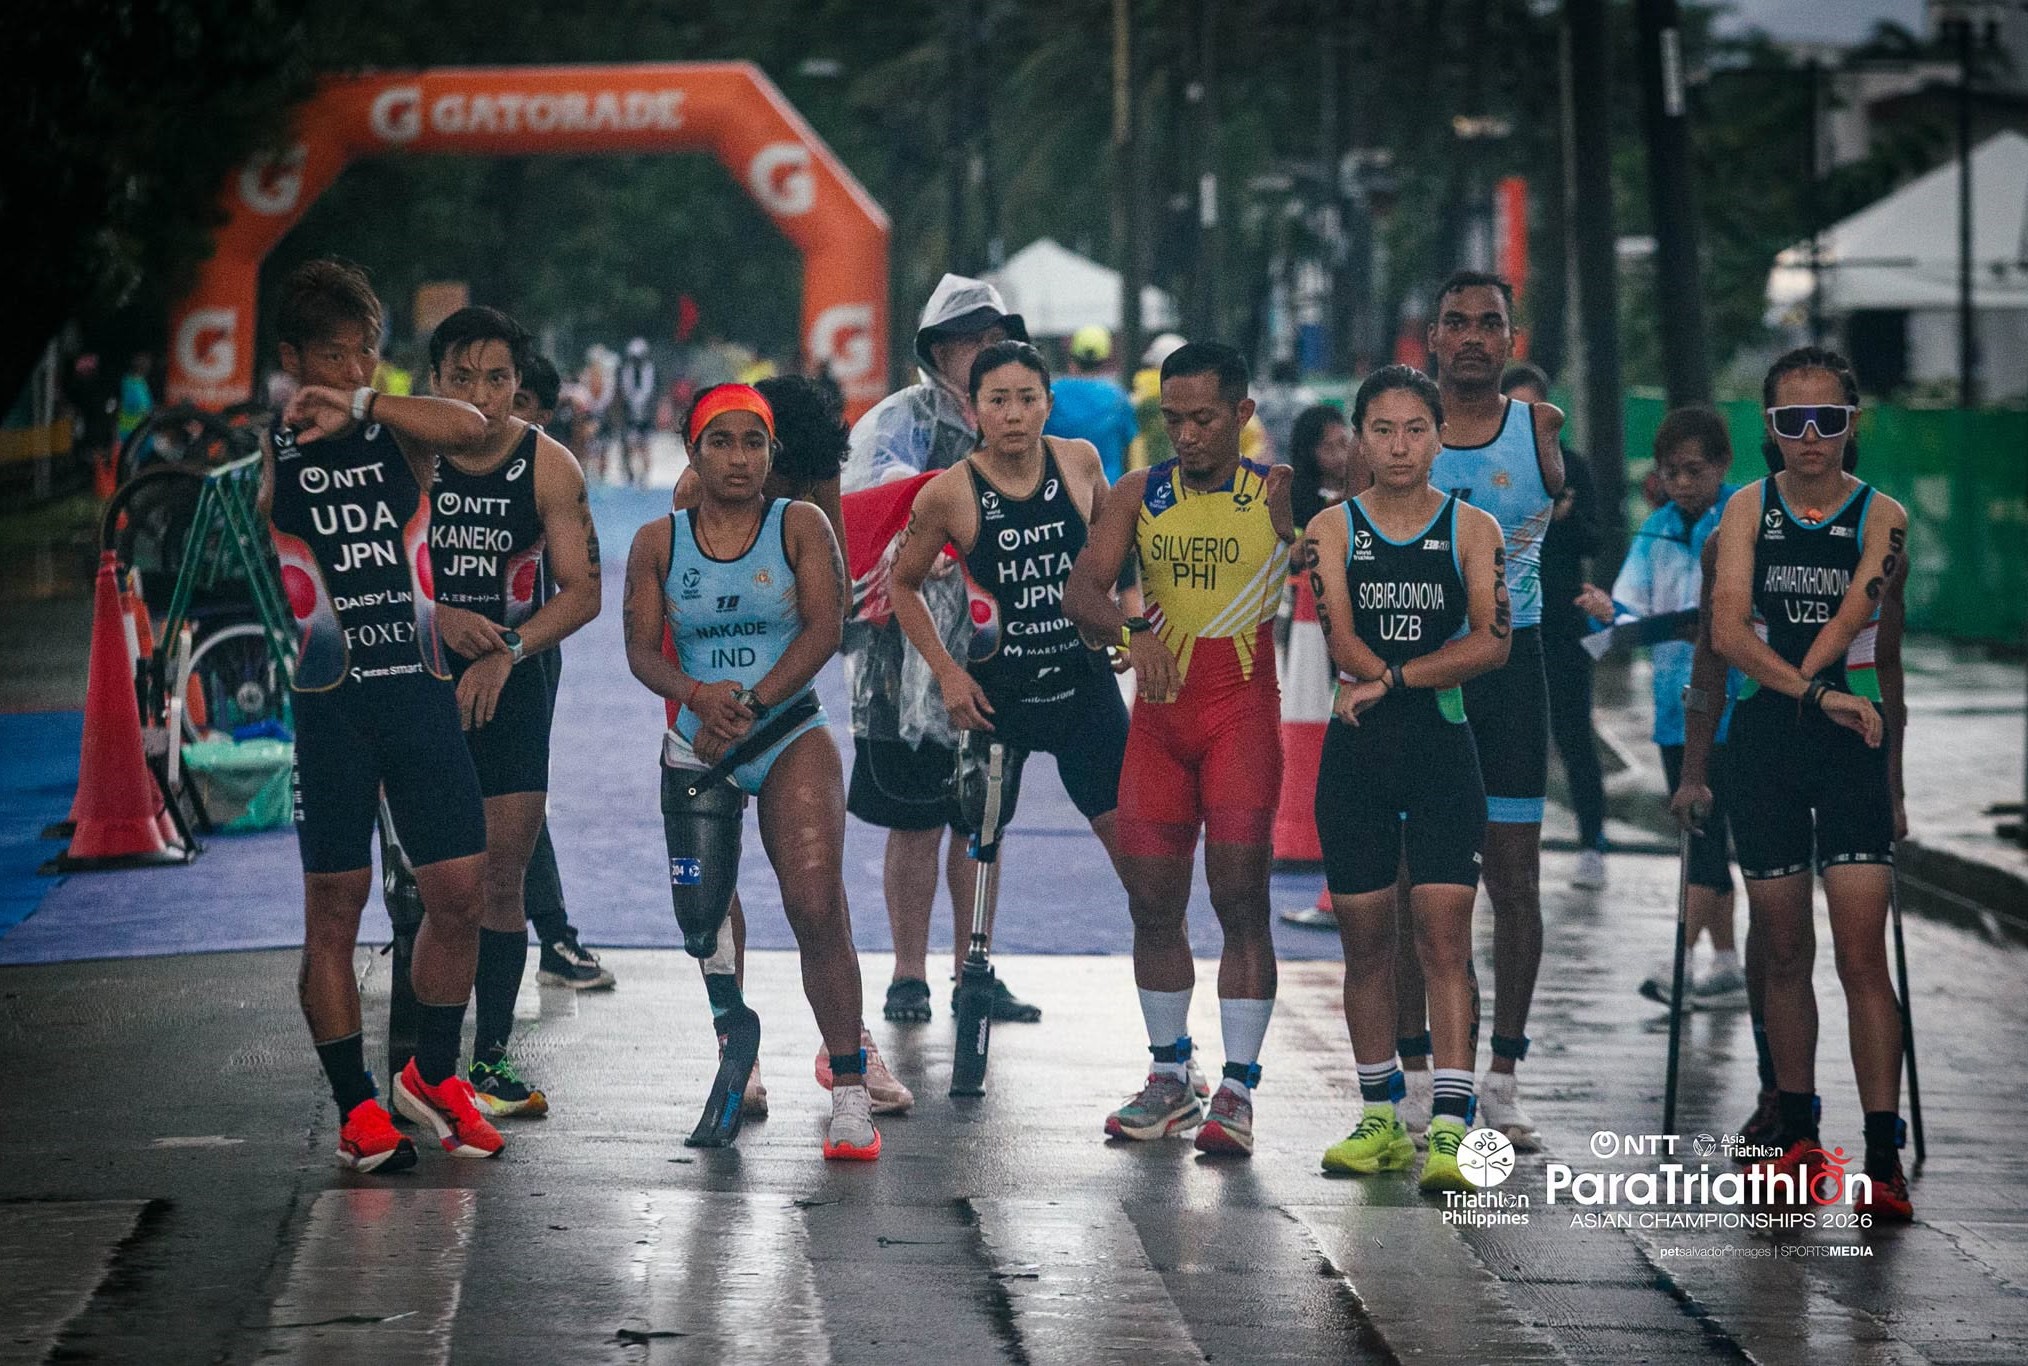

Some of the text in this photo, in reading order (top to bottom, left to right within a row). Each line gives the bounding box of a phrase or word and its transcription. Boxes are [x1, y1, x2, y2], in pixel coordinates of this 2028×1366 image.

[430, 87, 685, 133] GATORADE
[748, 141, 817, 216] G
[178, 308, 237, 380] G
[333, 462, 385, 489] NTT
[311, 500, 399, 536] UDA
[464, 496, 511, 517] NTT
[431, 525, 513, 552] KANEKO
[1023, 520, 1066, 545] NTT
[334, 540, 398, 573] JPN
[1151, 534, 1240, 564] SILVERIO
[444, 554, 498, 577] JPN
[997, 551, 1074, 584] HATA
[1172, 562, 1216, 591] PHI
[1014, 580, 1064, 610] JPN
[1358, 581, 1445, 611] SOBIRJONOVA
[1784, 599, 1830, 624] UZB
[343, 621, 417, 650] FOXEY
[695, 620, 767, 639] NAKADE
[1379, 614, 1422, 642] UZB
[711, 647, 756, 669] IND
[1026, 645, 1058, 656] MARS
